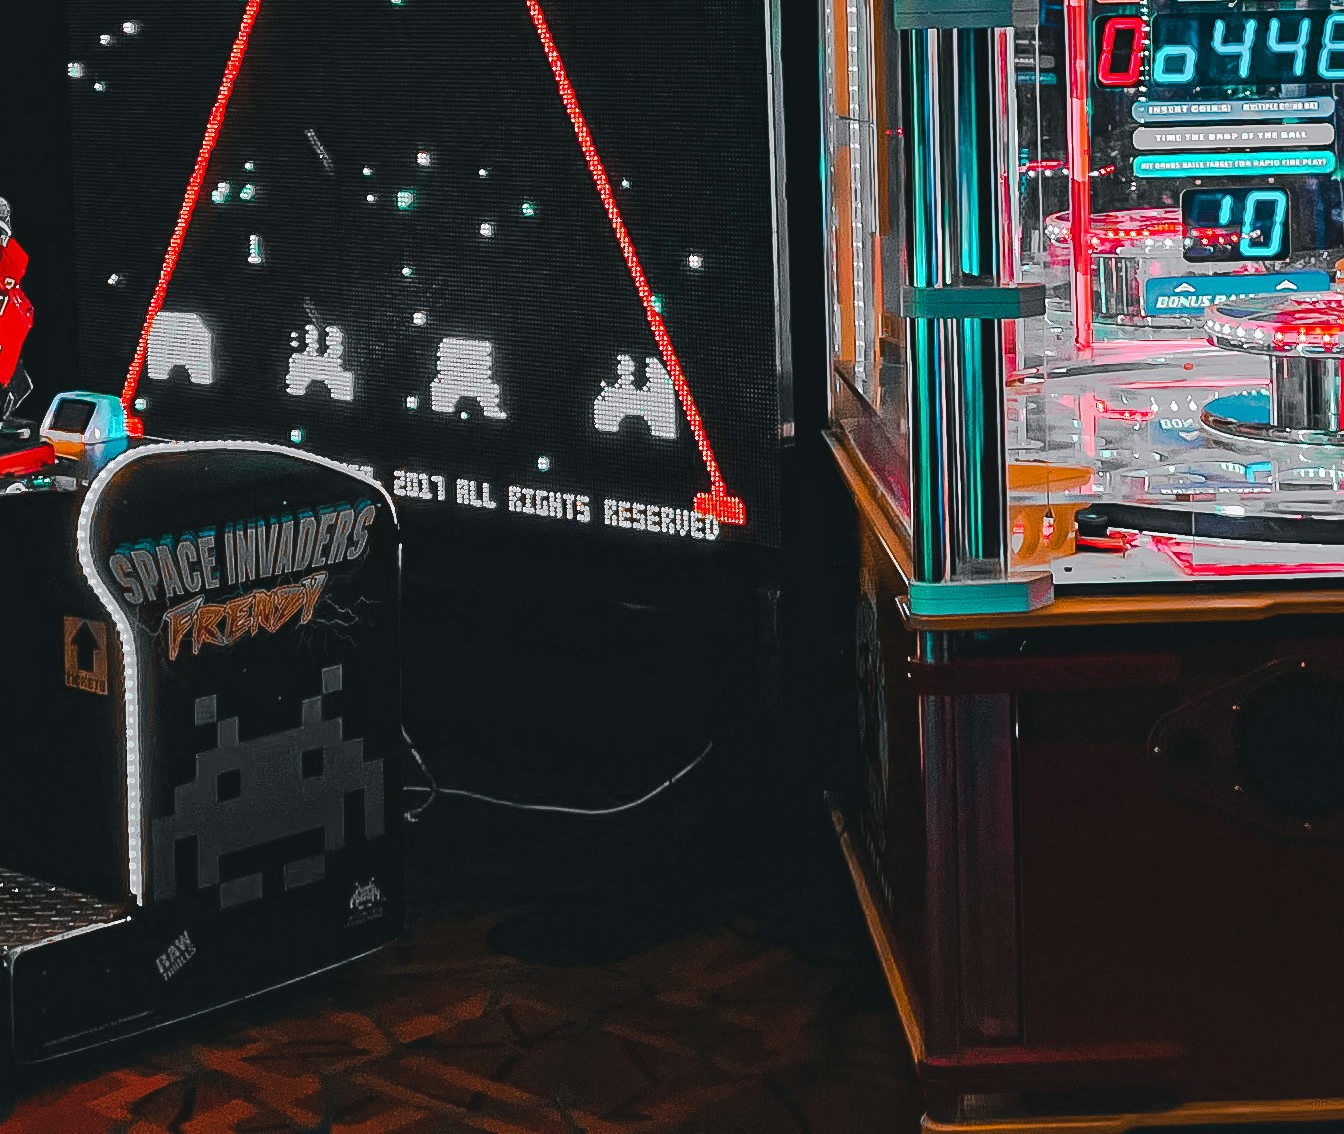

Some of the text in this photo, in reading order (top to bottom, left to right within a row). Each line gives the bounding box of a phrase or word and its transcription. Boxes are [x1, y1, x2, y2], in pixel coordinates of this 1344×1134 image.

[1154, 134, 1182, 143] TIME
[1185, 133, 1205, 142] THE
[1257, 131, 1278, 140] THE
[1156, 295, 1212, 309] BONUS
[393, 469, 446, 501] 2017
[456, 478, 497, 510] ALL
[507, 485, 591, 523] RIGHTS
[603, 498, 720, 541] RESERVED
[109, 504, 376, 605] SPACE INVADERS
[164, 571, 329, 662] FRENZY
